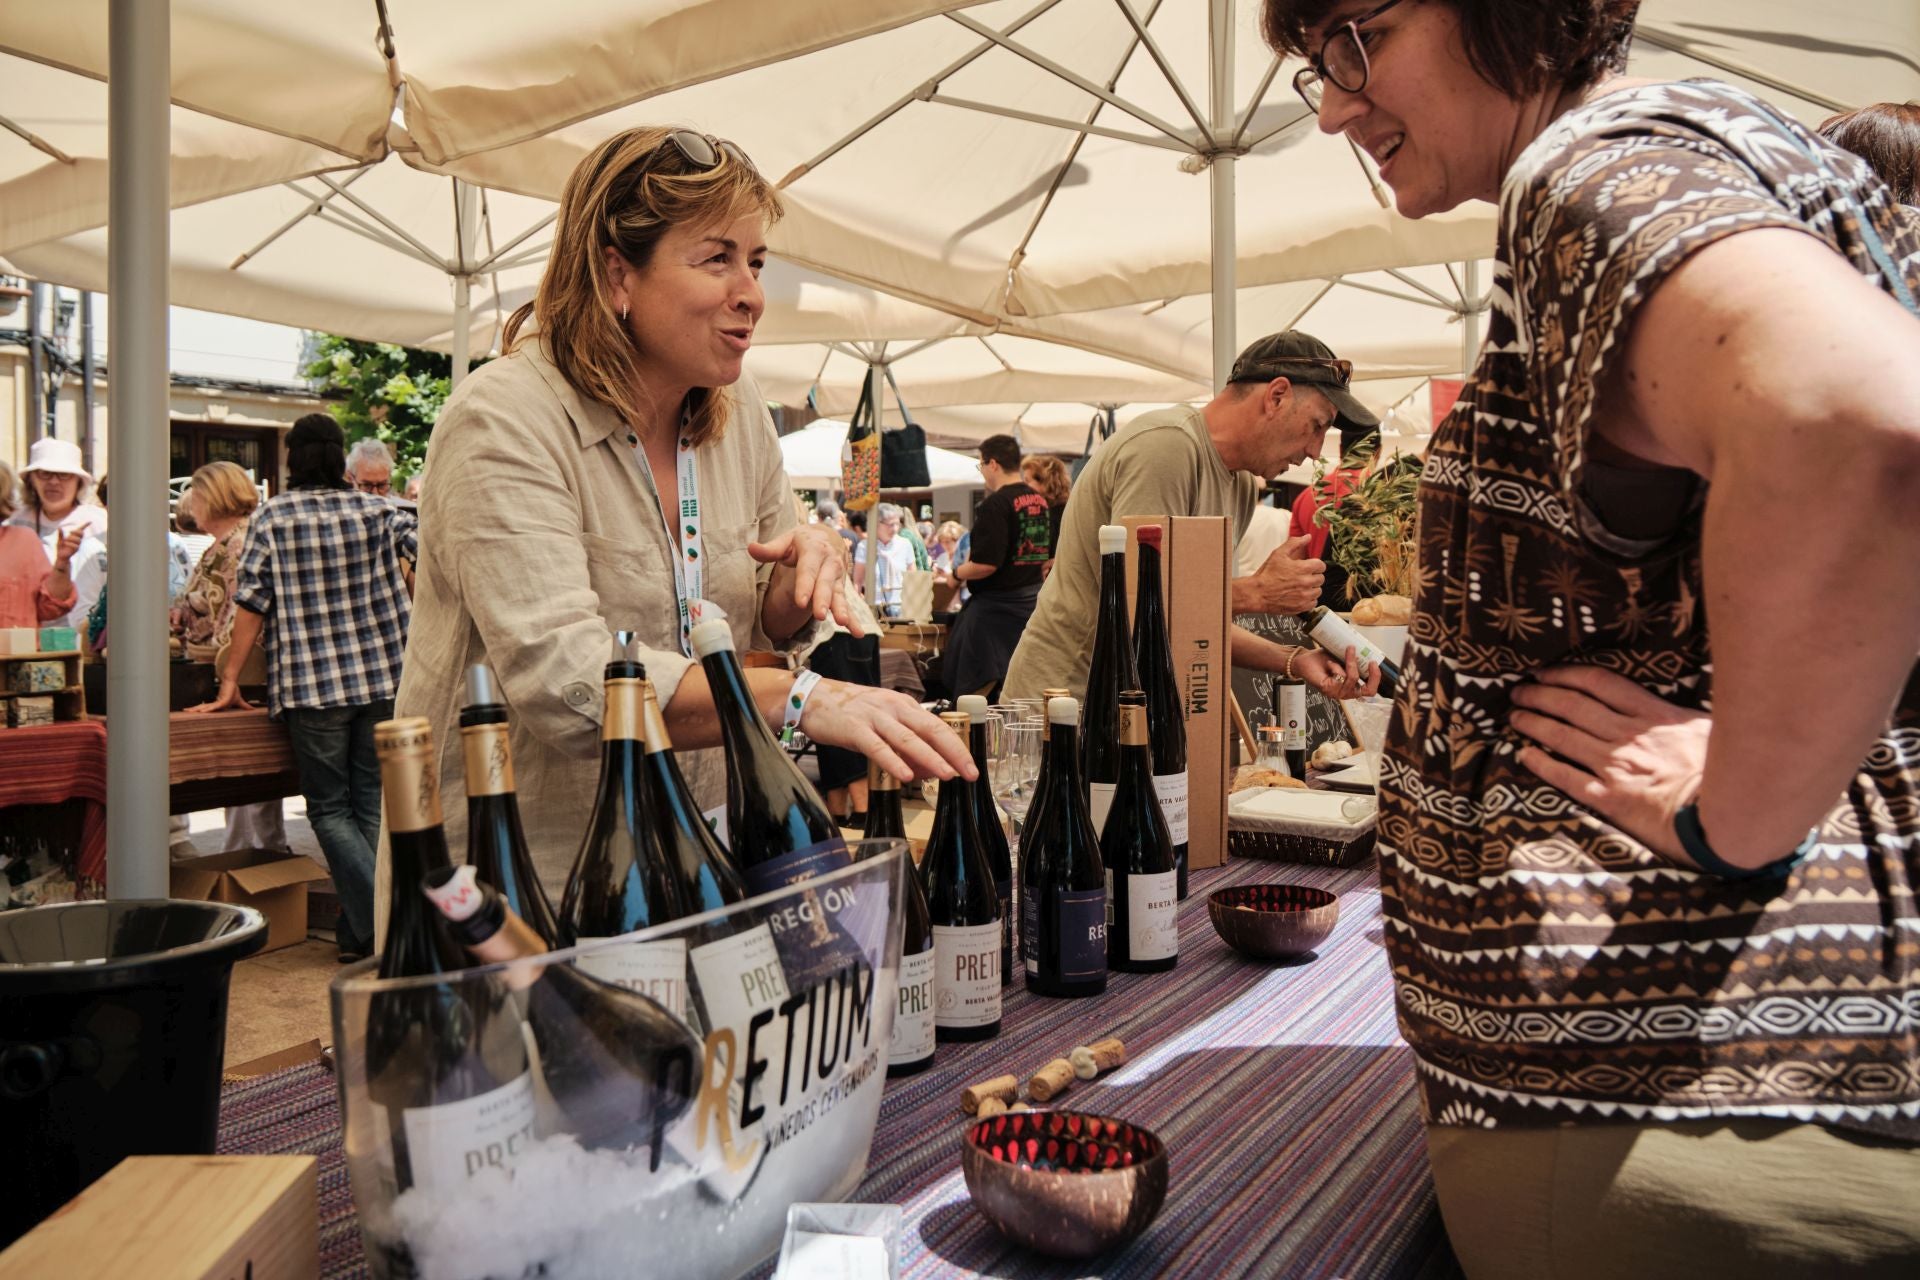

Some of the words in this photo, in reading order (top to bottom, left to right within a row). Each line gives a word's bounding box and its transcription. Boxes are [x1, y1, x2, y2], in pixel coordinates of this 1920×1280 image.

[1191, 639, 1210, 714] PRETIUM
[1148, 900, 1171, 910] BERTA
[955, 950, 1001, 982] PRETI
[650, 960, 874, 1175] PRETIUM
[819, 1047, 880, 1117] CENTENARIOS
